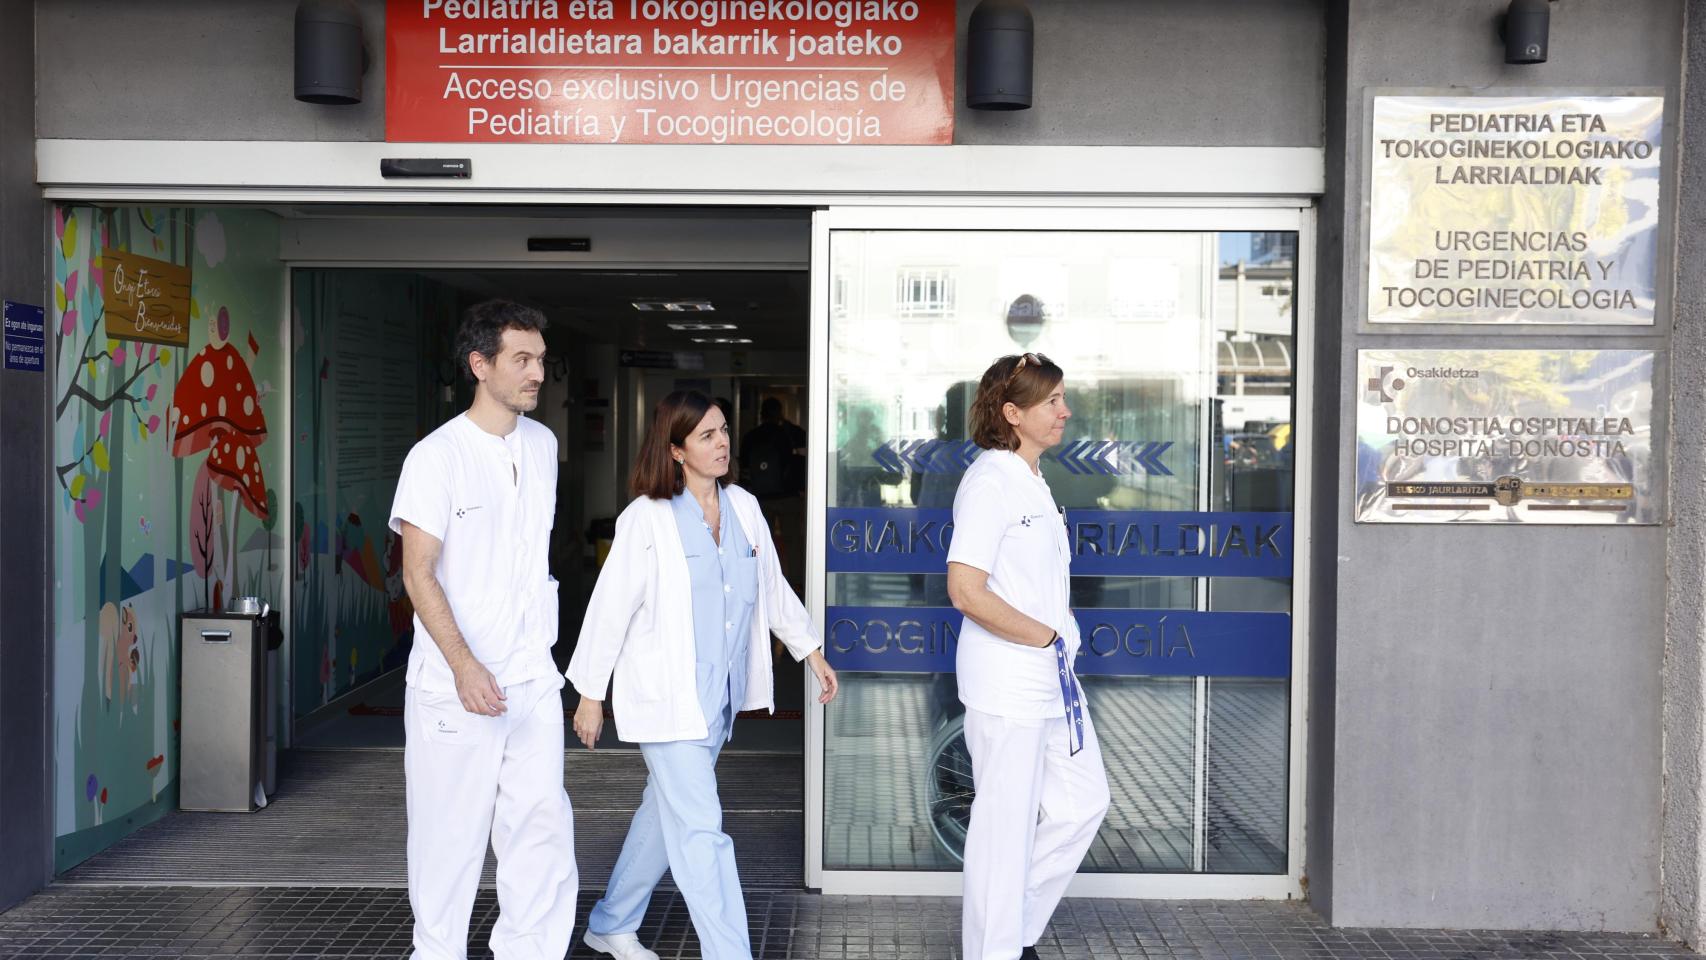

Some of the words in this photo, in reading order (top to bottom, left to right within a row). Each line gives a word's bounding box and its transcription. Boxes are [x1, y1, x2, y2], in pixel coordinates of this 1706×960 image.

[422, 0, 559, 19] Pediatria
[568, 0, 614, 20] eta
[628, 0, 919, 27] Tokoginekologiako
[439, 27, 642, 54] Larrialdietara
[653, 28, 779, 55] bakarrik
[786, 29, 902, 60] joateko
[443, 72, 552, 100] Acceso
[562, 73, 699, 101] exclusivo
[710, 74, 859, 108] Urgencias
[869, 74, 906, 101] de
[468, 107, 600, 135] Pediatría
[610, 115, 626, 143] y
[636, 108, 882, 144] Tocoginecología
[1429, 113, 1555, 133] PEDIATRIA
[1561, 114, 1607, 133] ETA
[1380, 139, 1652, 159] TOKOGINEKOLOGIAKO
[1435, 166, 1602, 185] LARRIALDIAK
[1435, 231, 1587, 251] URGENCIAS
[1415, 259, 1449, 279] DE
[1458, 260, 1592, 280] PEDIATRIA
[1596, 261, 1614, 280] Y
[1382, 287, 1637, 309] TOCOGINECOLOGIA
[1406, 366, 1479, 379] Osakidetza
[1386, 416, 1504, 436] DONOSTIA
[1508, 417, 1634, 436] OSPITALEA
[1393, 438, 1503, 457] HOSPITAL
[1508, 439, 1627, 458] DONOSTIA
[1071, 522, 1283, 558] RIALDIAK
